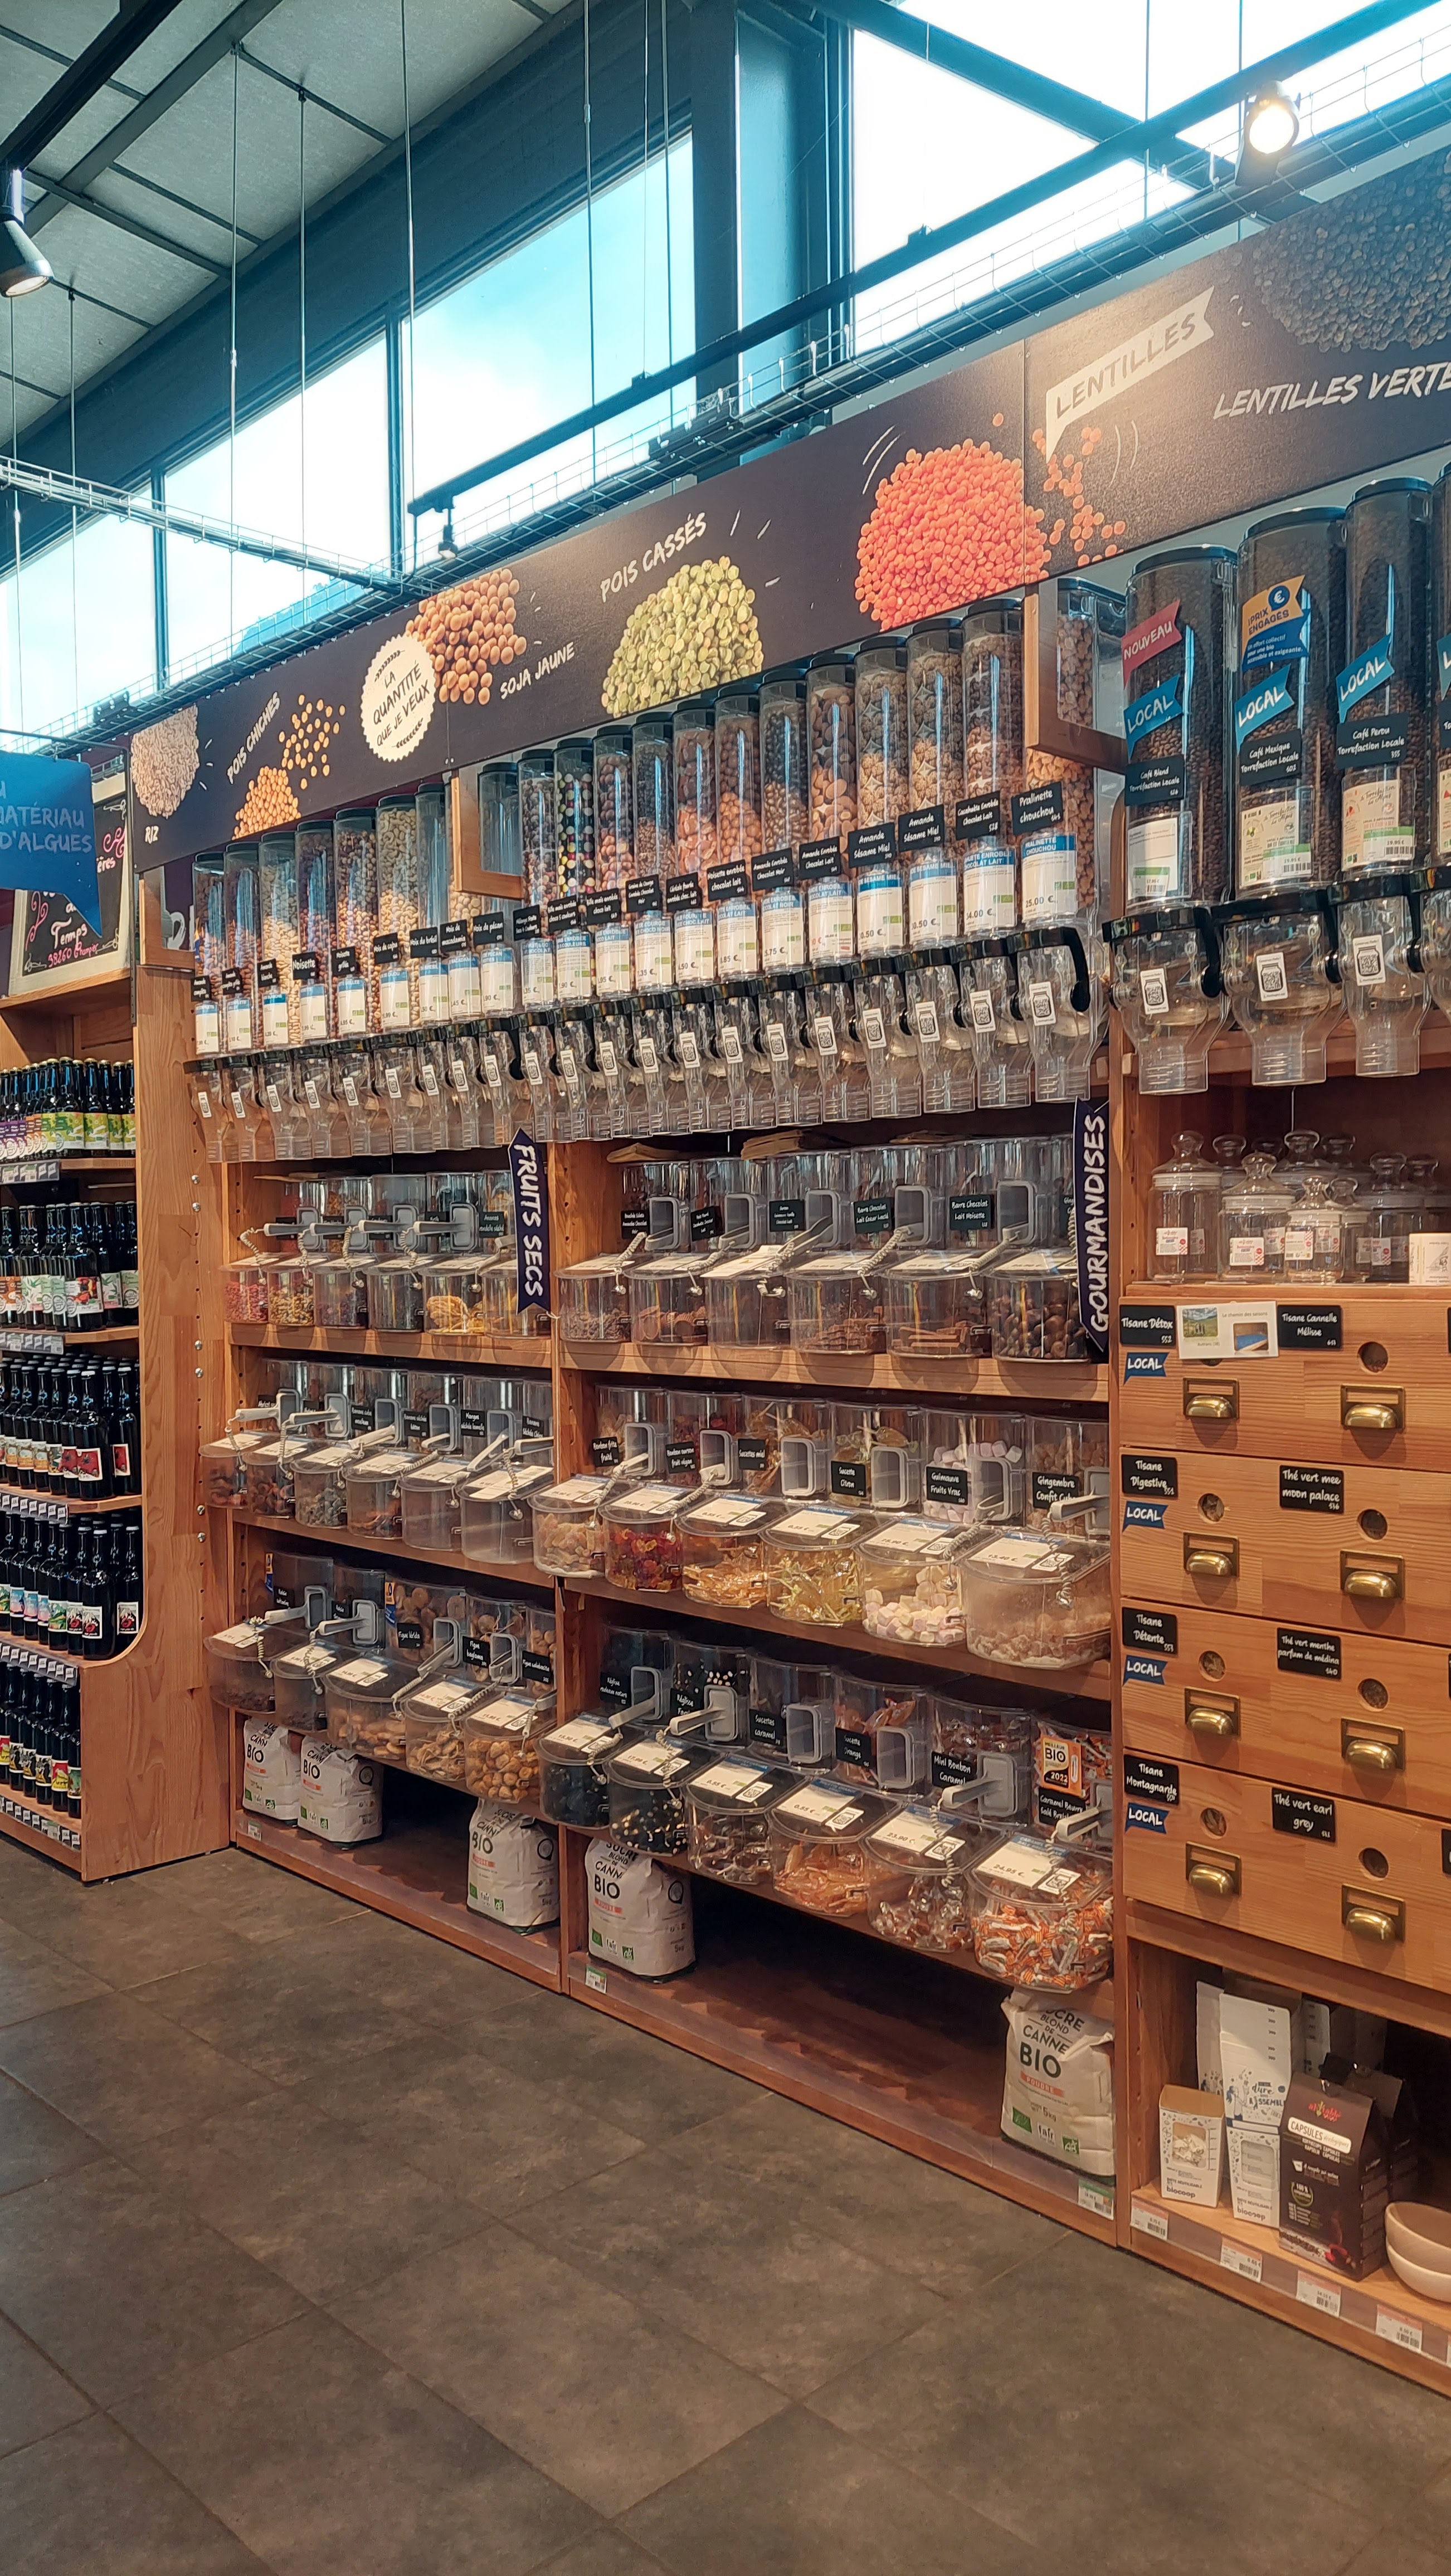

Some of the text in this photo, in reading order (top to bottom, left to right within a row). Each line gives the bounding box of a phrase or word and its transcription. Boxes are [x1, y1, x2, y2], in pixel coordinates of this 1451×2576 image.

[1055, 312, 1196, 418] LENTILLES
[1213, 373, 1363, 419] LENTILLES
[600, 512, 707, 602] POIS CASSÉS
[1249, 609, 1289, 635] ENGAGÉS
[1124, 620, 1172, 660] NOUVEAU
[1254, 634, 1286, 650] effort collectif
[1267, 643, 1275, 651] bio
[500, 642, 575, 700] SOJA JAUNE
[1340, 656, 1386, 702] LOCAL
[384, 671, 396, 689] LA
[373, 660, 422, 725] QUANTITÉ
[377, 679, 430, 747] QUE JE VEUX
[1127, 695, 1174, 735] LOCAL
[1238, 686, 1284, 728] LOCAL
[227, 691, 280, 784] POIS CHICHES
[1353, 727, 1390, 740] Café Perou
[1381, 736, 1405, 747] Locale
[1250, 742, 1291, 760] Café Mexique
[1279, 752, 1299, 764] Locale
[1140, 767, 1169, 780] Café Blend
[1162, 777, 1180, 786] Locale
[1019, 789, 1053, 807] Pralinette
[909, 812, 934, 828] Amande
[963, 812, 992, 826] Chocolat Lait
[1020, 807, 1054, 824] chouchou
[0, 830, 92, 853] D'ALGUES
[145, 826, 159, 843] RIZ
[859, 831, 884, 844] Amande
[904, 824, 939, 843] Sésame Miel
[854, 842, 890, 859] Sésame Miel
[1025, 838, 1056, 848] PRALINETTE
[1026, 845, 1056, 856] CHOUCHOU
[802, 850, 820, 859] Amande
[806, 856, 834, 869] Chocolat Lait
[707, 865, 745, 880] Noisette enrobée
[753, 861, 771, 871] Amande
[757, 868, 786, 880] Chocolat Noir
[711, 877, 741, 891] chocolat lait
[1025, 895, 1054, 908] 25.00 €
[51, 916, 87, 949] Temps
[490, 921, 503, 933] pécan
[48, 948, 72, 968] 38260
[293, 958, 315, 970] Noisette
[514, 1144, 544, 1297] FRUITS SECS
[1084, 1114, 1109, 1333] GOURMANDISES
[1121, 1317, 1173, 1330] Tisane Détox
[1282, 1313, 1337, 1324] Tisane Cannelle
[1297, 1326, 1322, 1337] Mélisse
[1127, 1358, 1163, 1370] LOCAL
[1135, 1460, 1163, 1472] Tisane
[931, 1472, 960, 1484] Guimauve
[1037, 1475, 1075, 1490] Gingembre
[1130, 1476, 1167, 1490] Digestive
[1282, 1469, 1341, 1485] Thé vert mee
[931, 1484, 961, 1497] Fruits Vrac
[1036, 1490, 1058, 1503] Confit
[1282, 1489, 1340, 1505] moon palace
[1127, 1507, 1161, 1522] LOCAL
[1136, 1613, 1163, 1628] Tisane
[1133, 1629, 1165, 1645] Détente
[1282, 1635, 1335, 1652] Thé vert menthe
[1278, 1650, 1340, 1666] parfum de médina
[1127, 1660, 1161, 1677] LOCAL
[247, 1744, 264, 1763] BIO
[1045, 1748, 1066, 1763] BIO
[303, 1759, 320, 1779] BIO
[934, 1757, 971, 1774] Mini Bonbon
[1138, 1763, 1163, 1778] Tisane
[939, 1772, 967, 1784] Caramel
[1051, 1772, 1068, 1783] 2022
[1126, 1775, 1177, 1796] Montagnarde
[1274, 1793, 1333, 1816] Thé vert earl
[1128, 1808, 1163, 1826] LOCAL
[1293, 1817, 1314, 1832] grey
[472, 1832, 494, 1855] BIO
[594, 1874, 620, 1899] BIO
[1040, 2014, 1070, 2035] BLOND
[1045, 2025, 1054, 2034] DE
[1022, 2024, 1069, 2056] CANNE
[1019, 2041, 1062, 2079] BIO
[1026, 2076, 1055, 2094] POUDRE
[1291, 2120, 1323, 2141] CAPSULES
[1166, 2185, 1196, 2199] biocoop
[1237, 2205, 1265, 2221] biocoop
